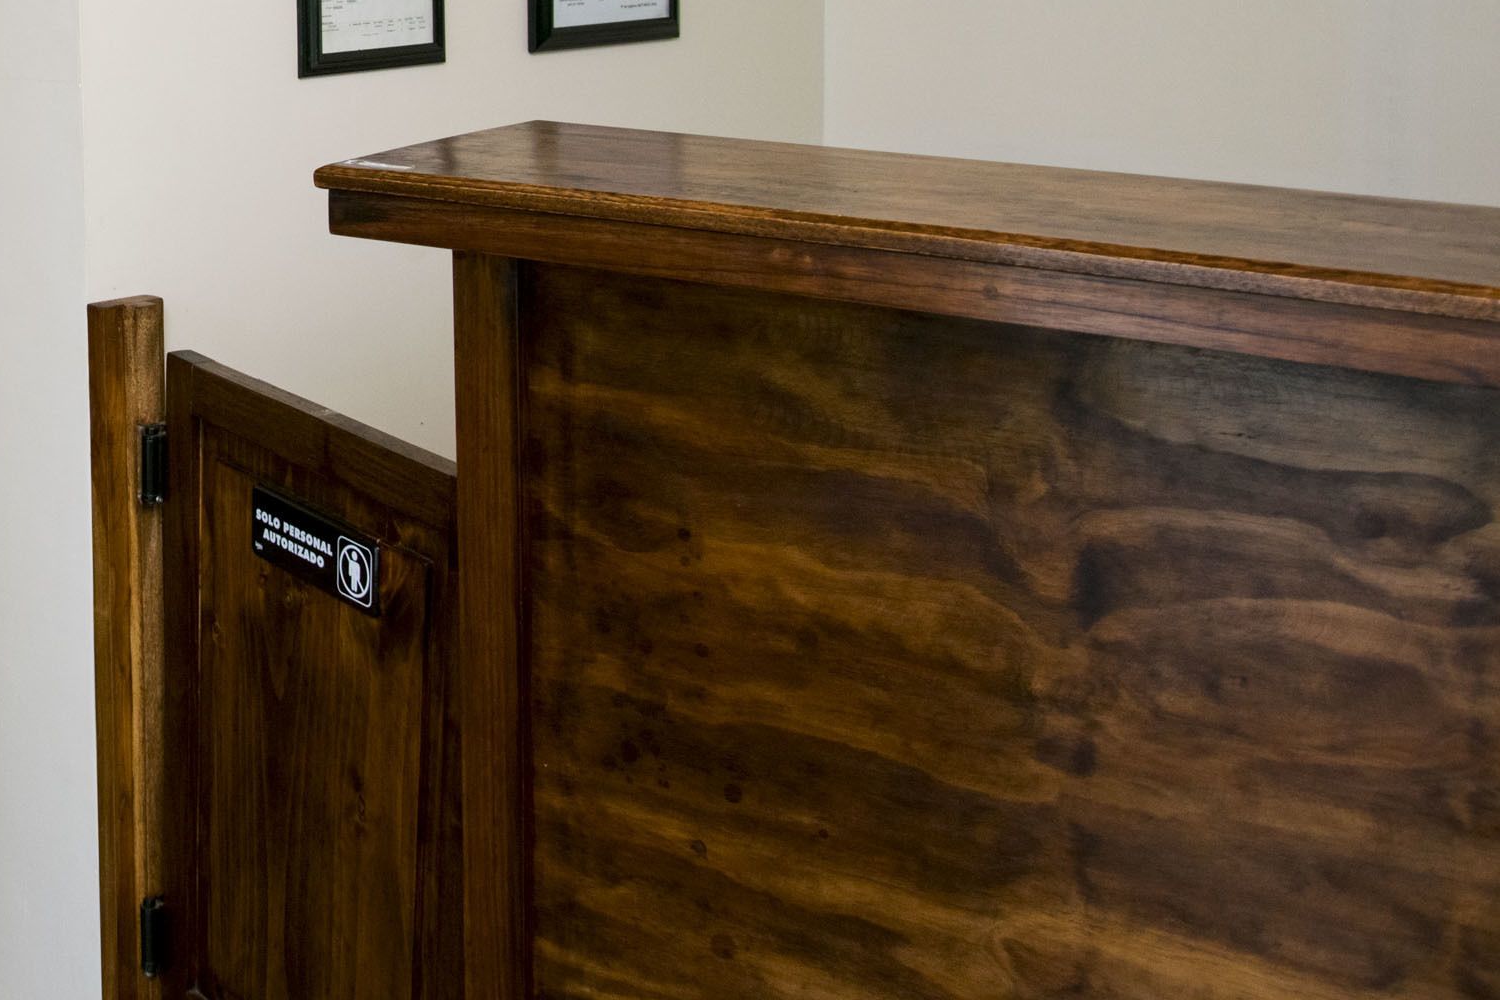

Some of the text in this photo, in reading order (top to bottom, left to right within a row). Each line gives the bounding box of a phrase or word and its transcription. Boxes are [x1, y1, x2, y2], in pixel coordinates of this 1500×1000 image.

[255, 508, 334, 557] SOLO PERSONAL
[262, 528, 325, 569] AUTORIZADO
